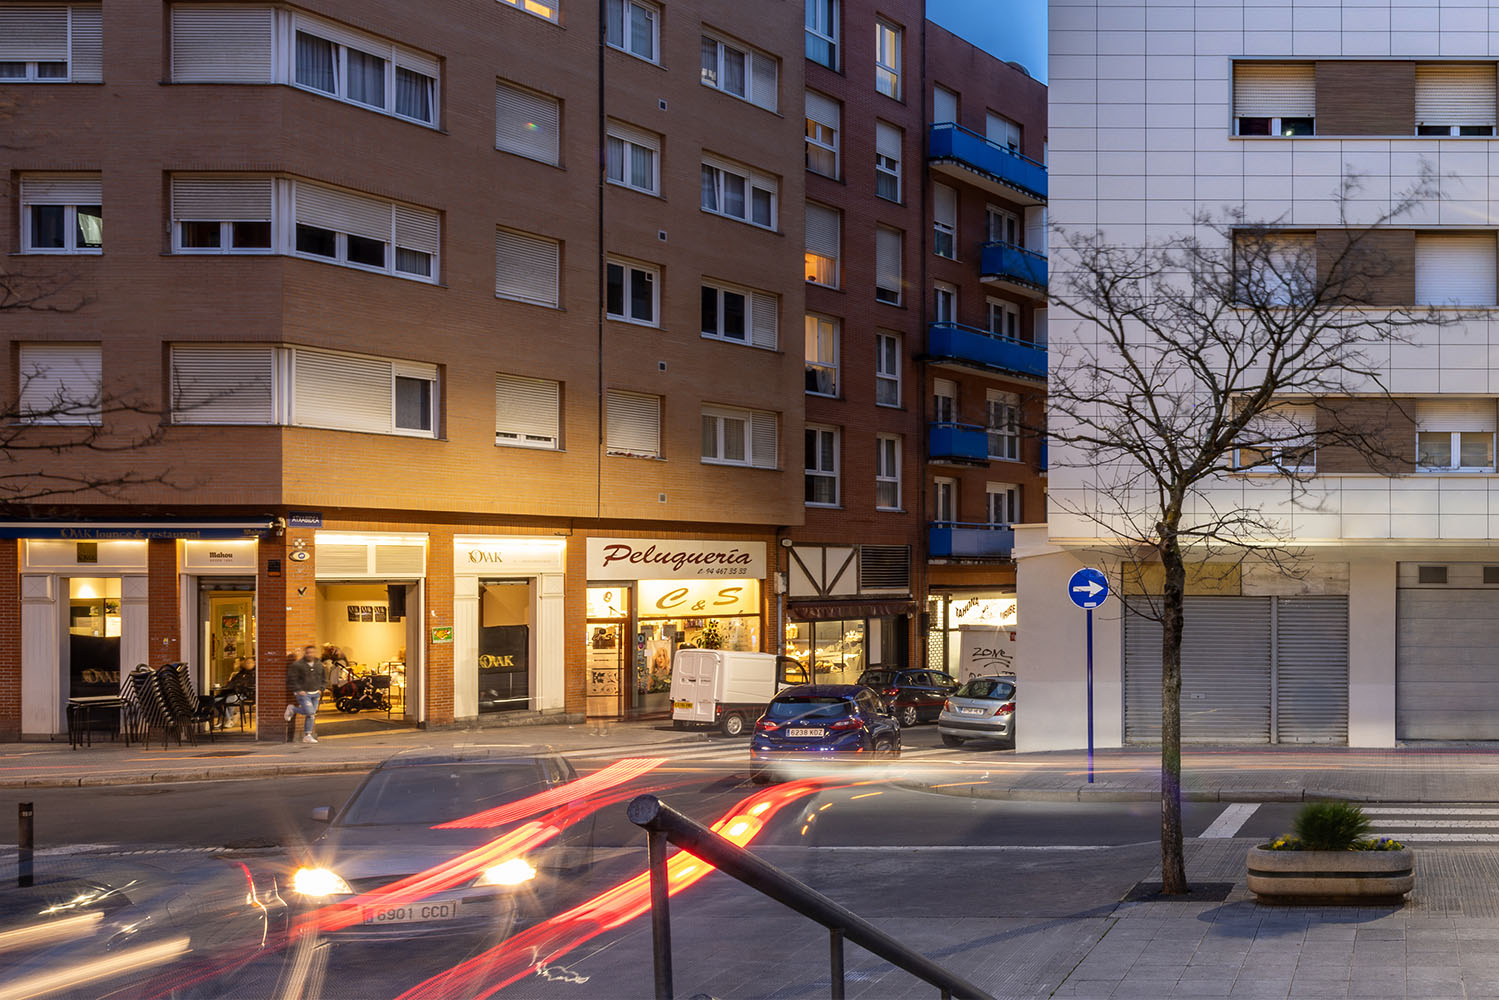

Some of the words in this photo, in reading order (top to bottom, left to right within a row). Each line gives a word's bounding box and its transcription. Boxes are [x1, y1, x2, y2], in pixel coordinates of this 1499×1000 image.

[603, 544, 753, 571] Peluquería
[655, 587, 689, 610] C
[691, 600, 706, 611] &
[713, 587, 743, 606] S
[790, 729, 808, 737] 6238
[376, 908, 413, 921] 6901
